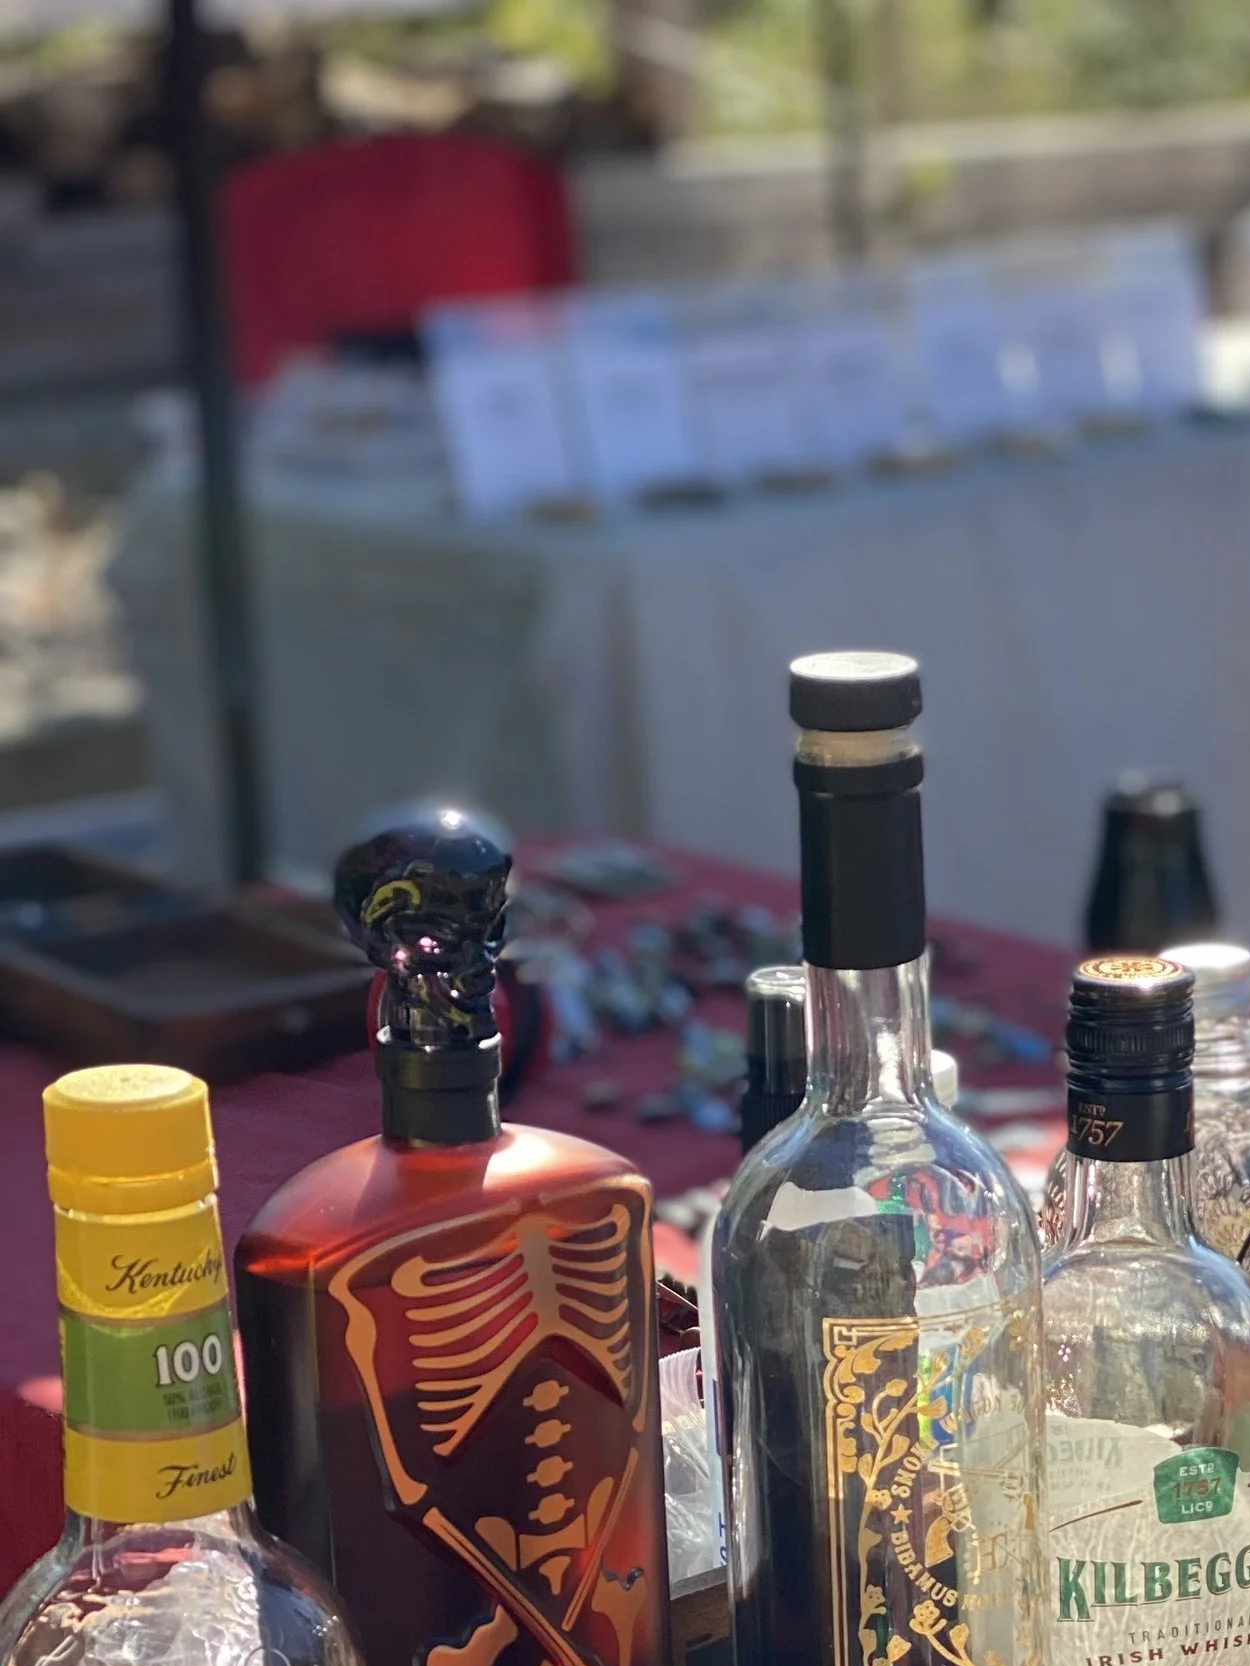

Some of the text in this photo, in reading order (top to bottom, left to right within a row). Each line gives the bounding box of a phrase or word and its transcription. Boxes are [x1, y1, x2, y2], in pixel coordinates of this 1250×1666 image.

[1070, 1114, 1123, 1147] 1757
[105, 1249, 222, 1294] Kentucky
[153, 1333, 223, 1388] 100
[156, 1451, 236, 1499] Finest
[1172, 1477, 1222, 1500] 1757
